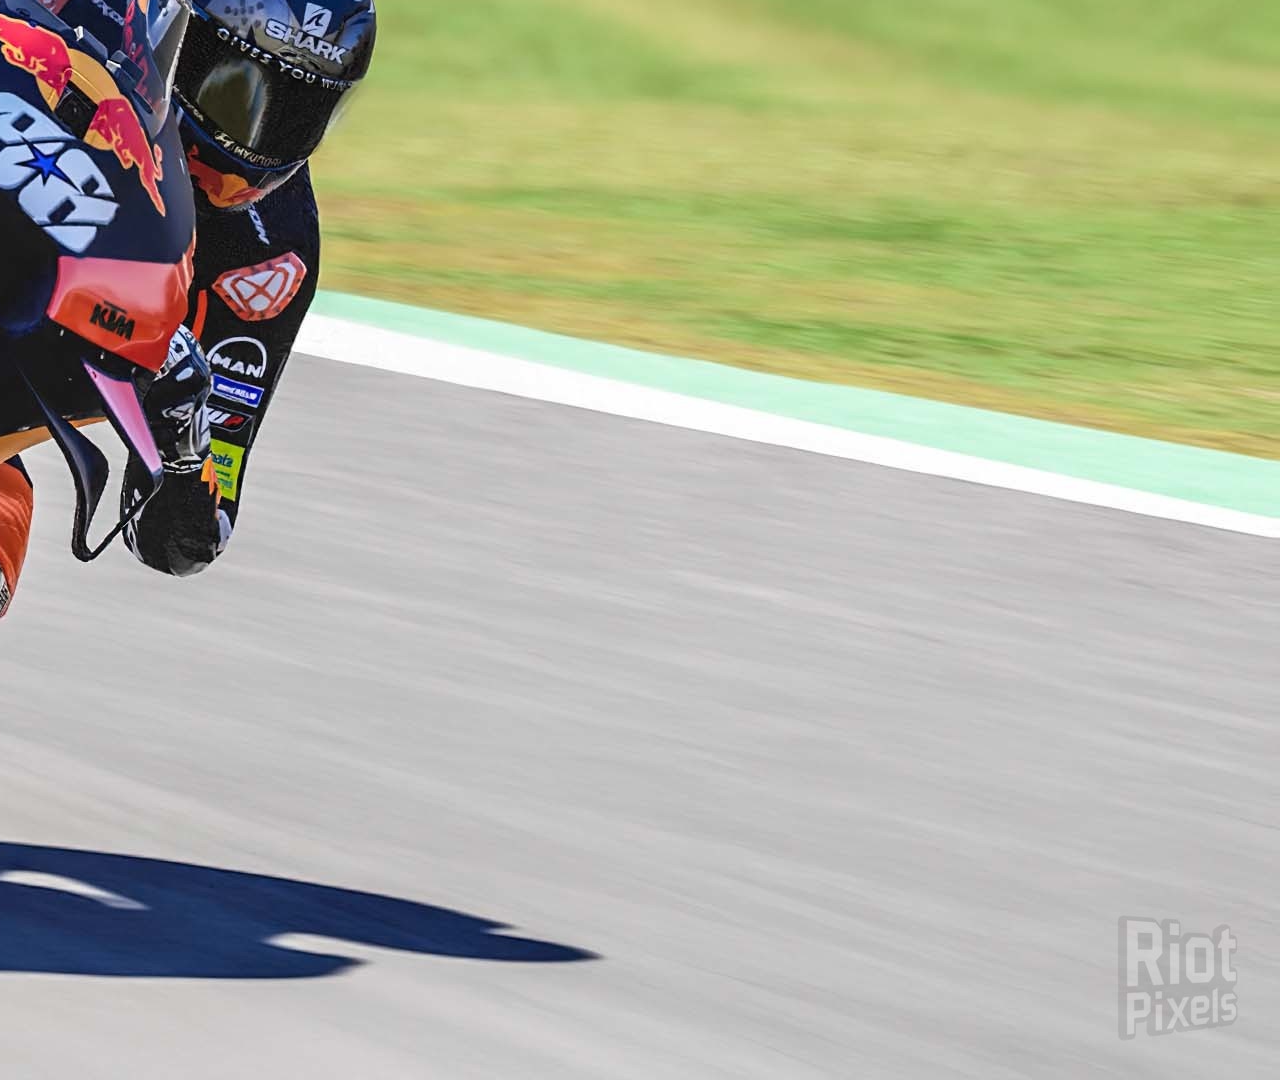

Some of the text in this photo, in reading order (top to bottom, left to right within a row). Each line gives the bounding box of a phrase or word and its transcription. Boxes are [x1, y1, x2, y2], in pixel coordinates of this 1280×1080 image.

[265, 18, 347, 64] SHARK
[279, 60, 316, 84] YOU
[89, 300, 136, 341] KTM
[211, 352, 263, 378] MAN
